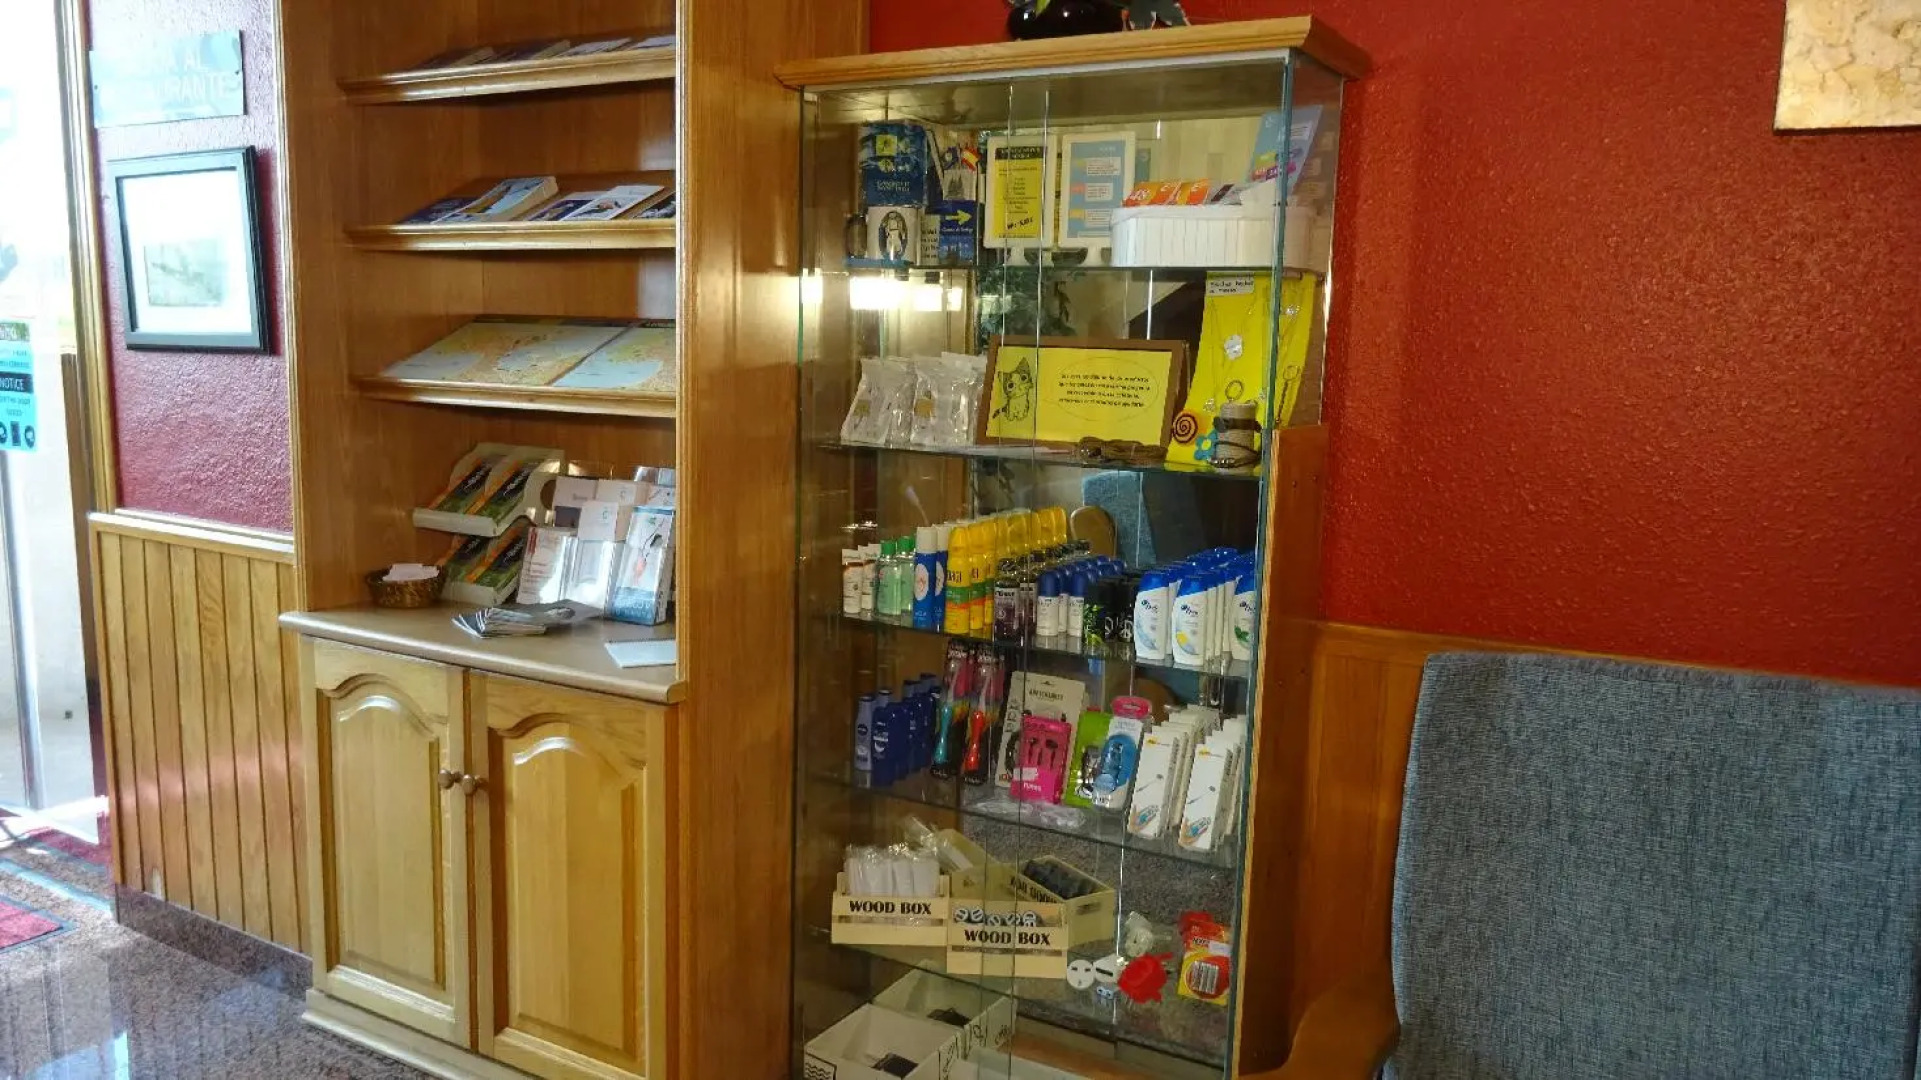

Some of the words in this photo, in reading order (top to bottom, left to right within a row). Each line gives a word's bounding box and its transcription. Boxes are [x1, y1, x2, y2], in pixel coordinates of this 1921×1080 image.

[849, 900, 895, 913] WOOD
[900, 902, 932, 915] BOX
[964, 929, 1012, 945] WOOD
[1018, 931, 1051, 946] BOX
